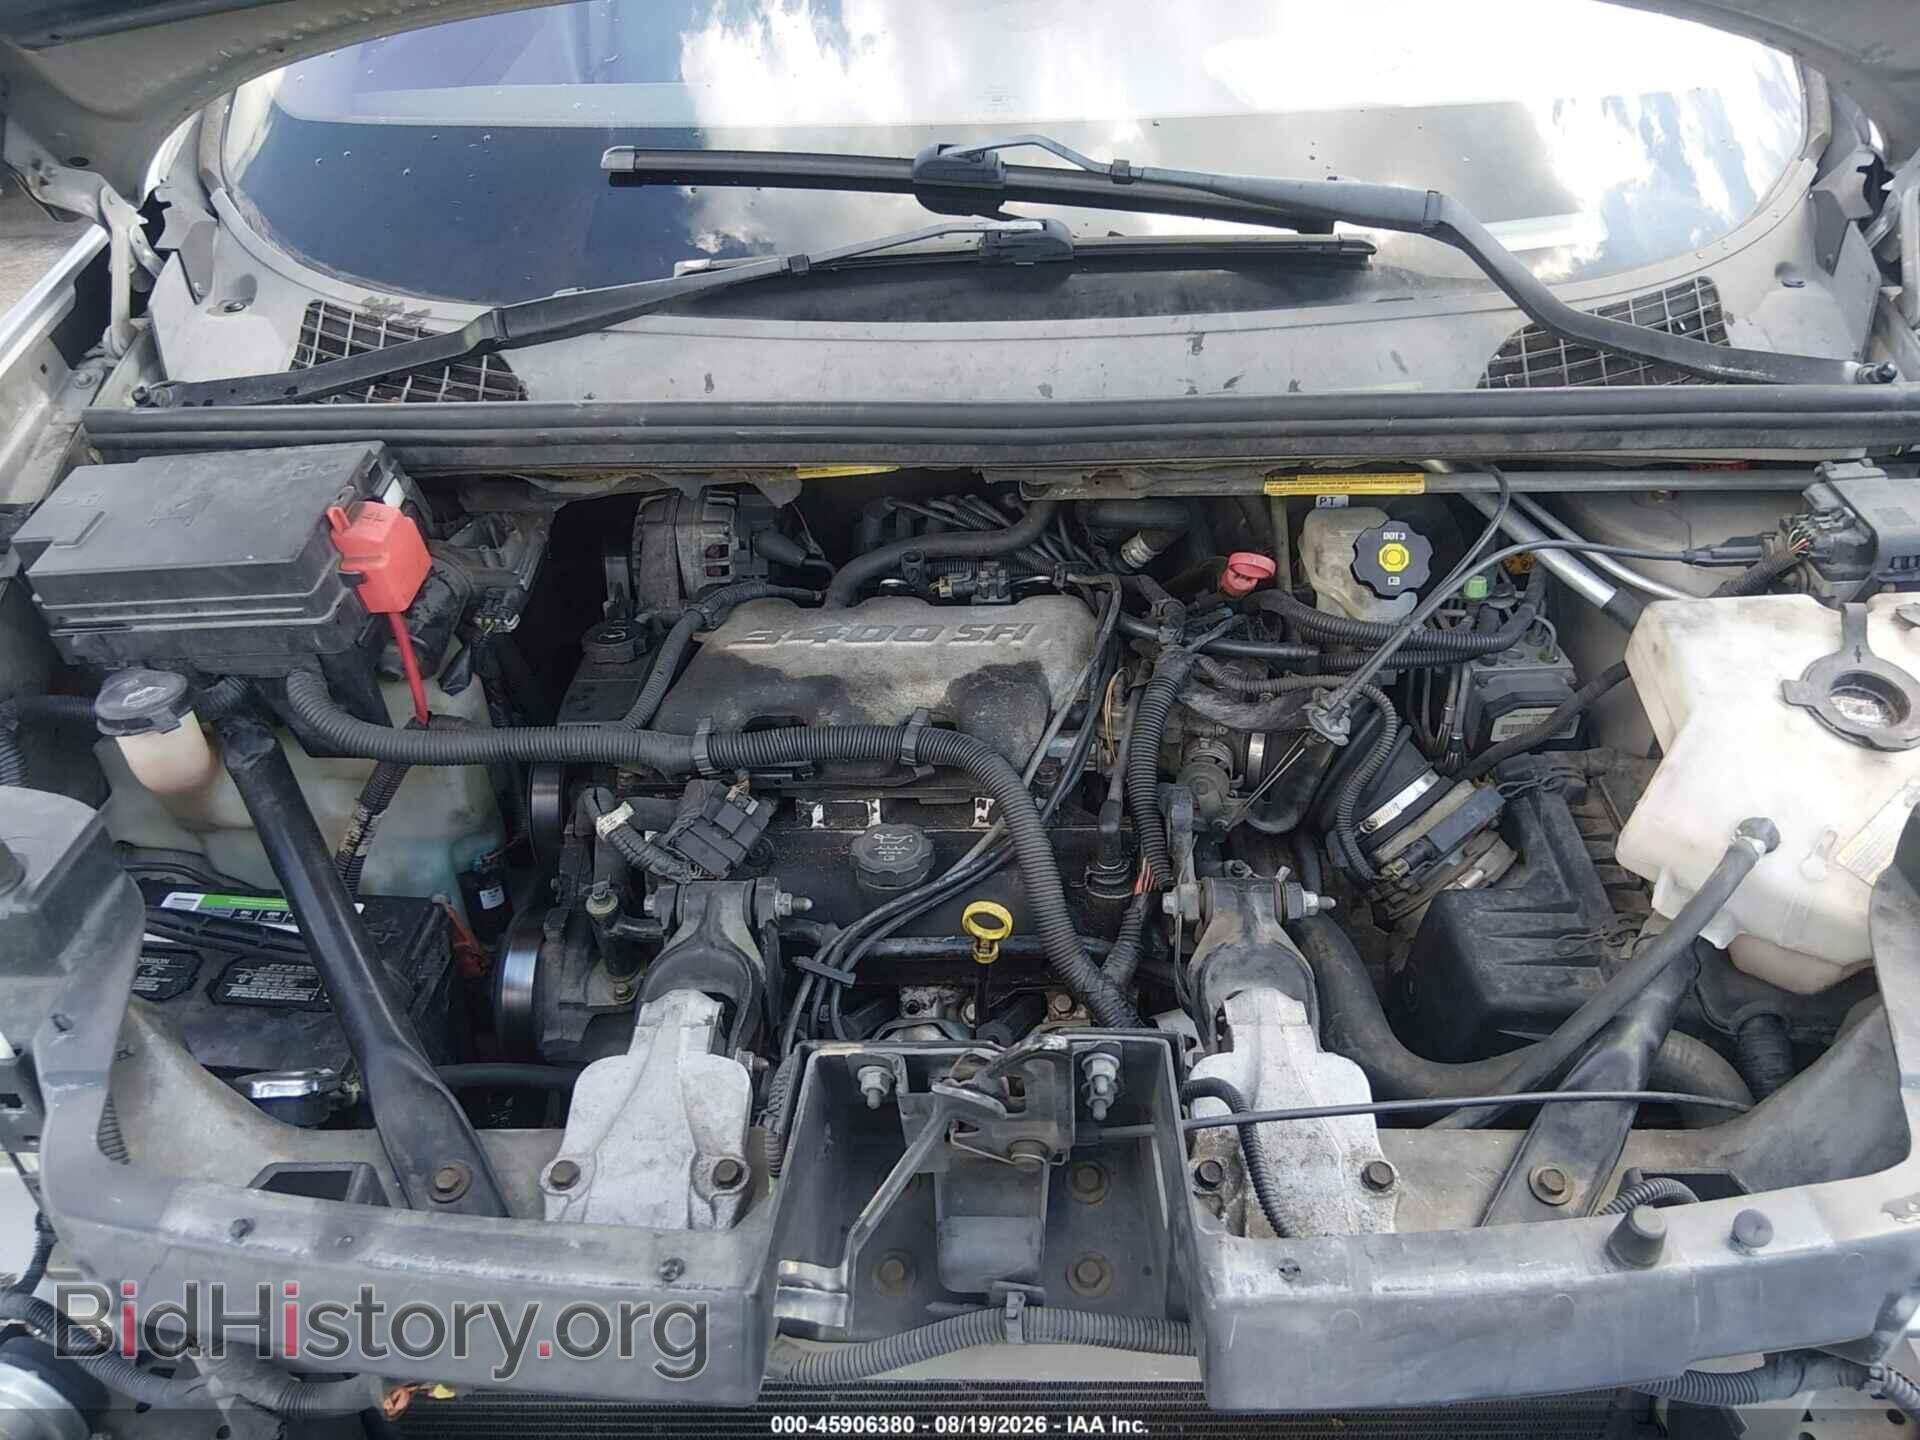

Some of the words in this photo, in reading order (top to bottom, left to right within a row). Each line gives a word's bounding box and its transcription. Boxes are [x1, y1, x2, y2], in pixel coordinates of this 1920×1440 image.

[1383, 531, 1399, 540] DOT
[728, 623, 945, 648] 3400
[949, 623, 1034, 647] SFI
